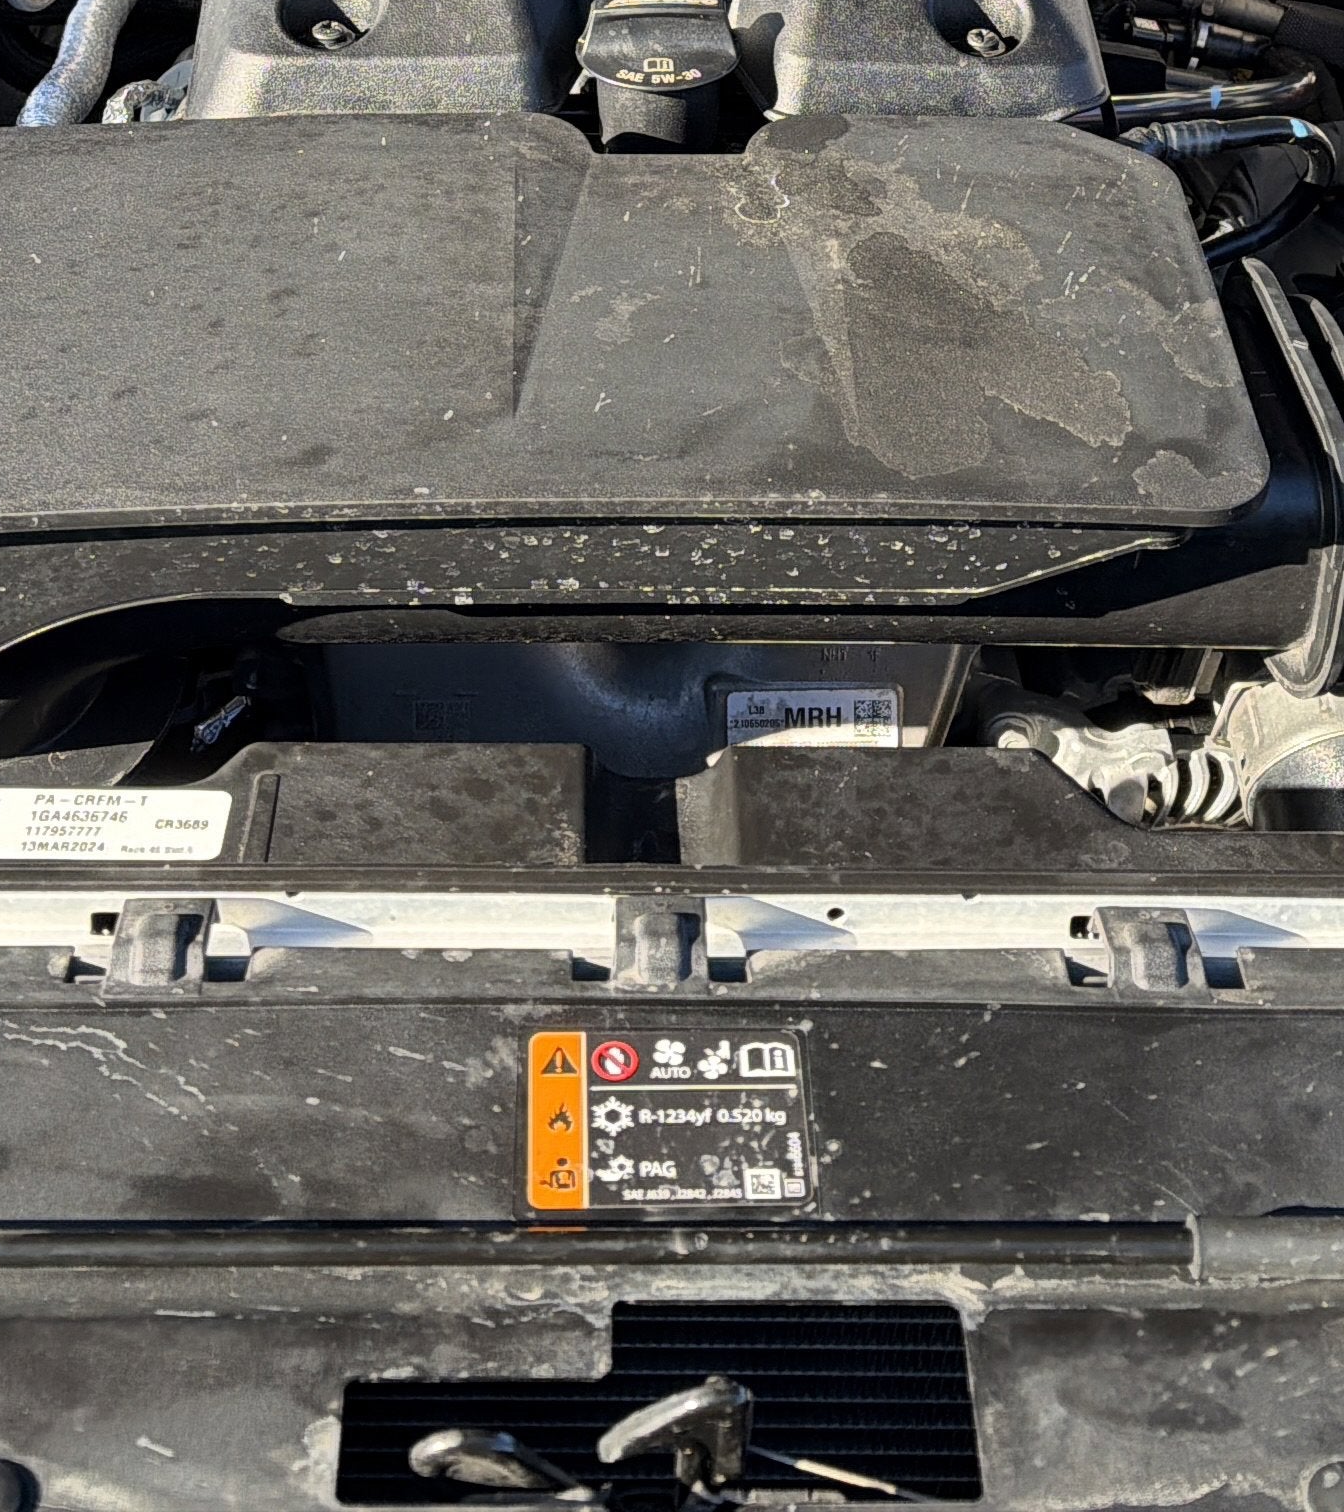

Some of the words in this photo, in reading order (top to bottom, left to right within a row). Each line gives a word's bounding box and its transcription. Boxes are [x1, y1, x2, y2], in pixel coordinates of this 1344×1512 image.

[616, 69, 644, 83] SAE
[651, 68, 702, 84] 5W-30
[748, 705, 765, 715] L3B
[784, 706, 842, 728] MRH
[25, 825, 102, 837] 117957777
[154, 818, 209, 831] CR3689
[21, 840, 106, 852] 13MAR2024
[650, 1066, 692, 1080] AUTO
[638, 1109, 713, 1127] R-1234yf
[716, 1110, 763, 1124] 0.520
[765, 1108, 787, 1126] kg
[638, 1161, 678, 1178] PAG
